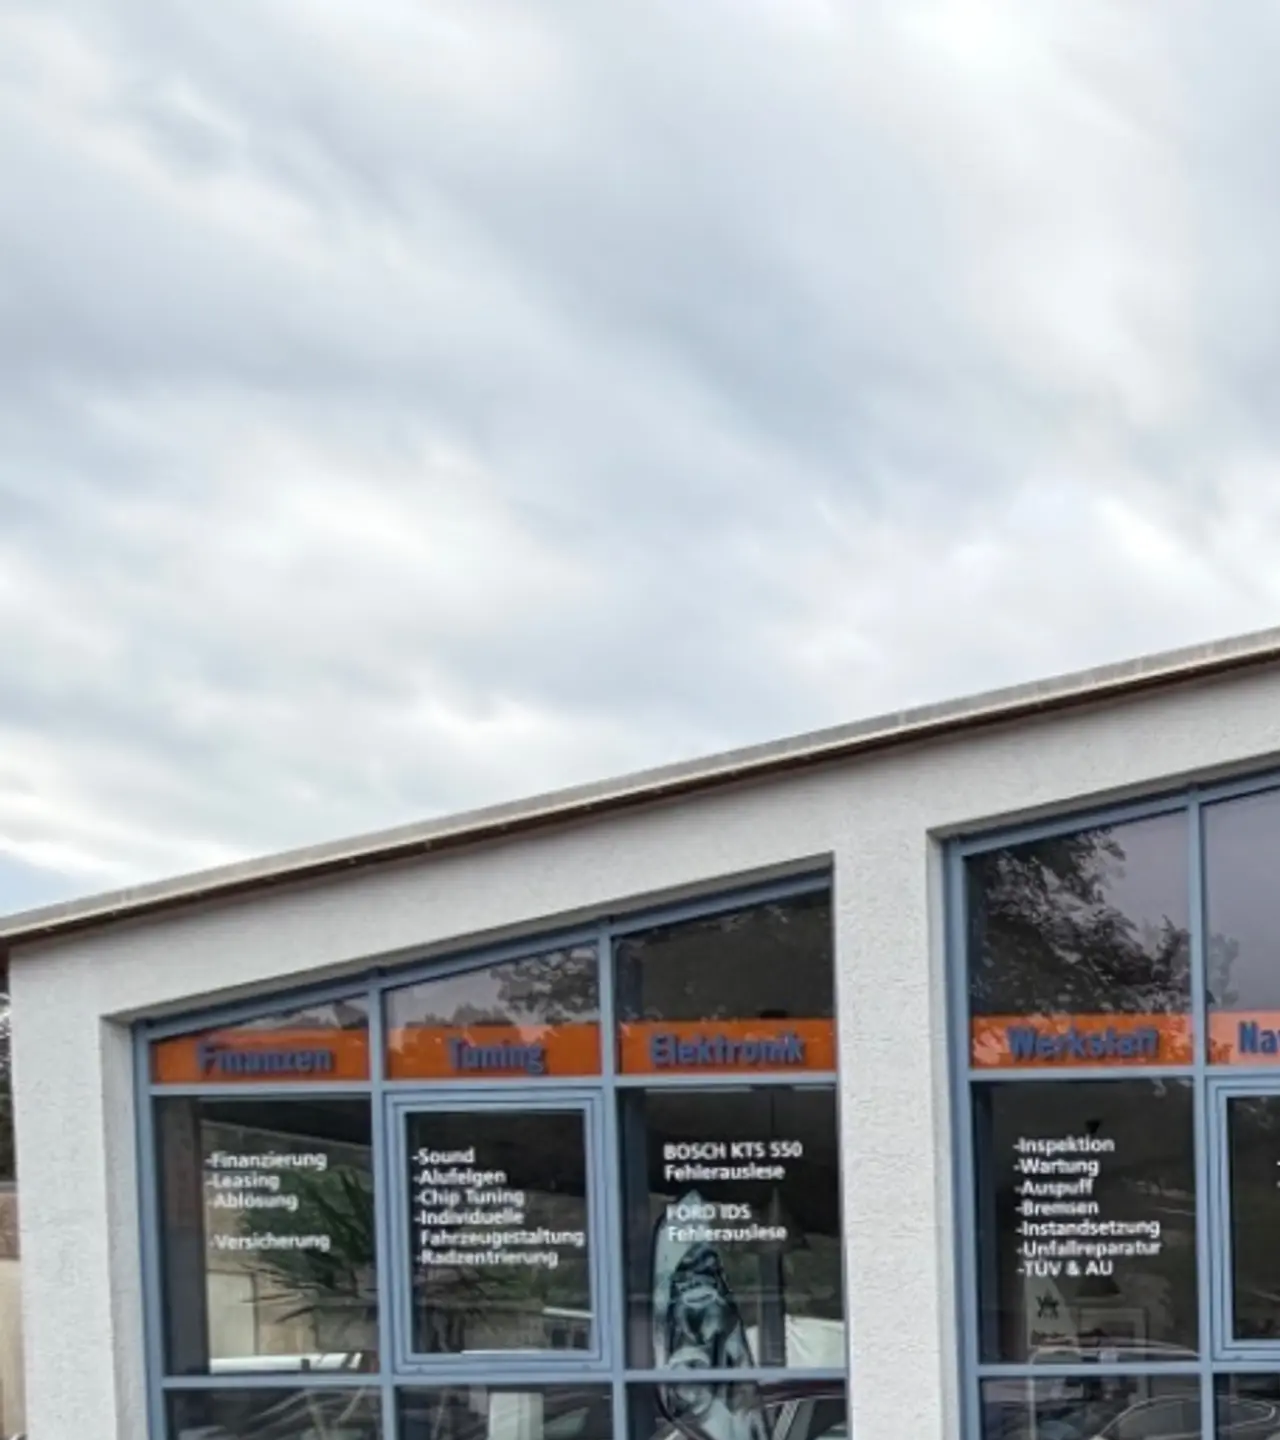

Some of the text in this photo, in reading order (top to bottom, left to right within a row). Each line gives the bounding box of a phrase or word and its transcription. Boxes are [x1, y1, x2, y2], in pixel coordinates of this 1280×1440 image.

[446, 1036, 545, 1075] Tuning
[650, 1031, 806, 1066] Elektronik
[662, 1139, 804, 1161] BOSCH KTS 550
[663, 1161, 787, 1182] Fehlerauslese
[465, 1187, 525, 1208] Tuning
[665, 1202, 752, 1222] FORD IDS
[667, 1223, 790, 1243] Fehlerauslese
[1065, 1259, 1081, 1277] &
[1084, 1259, 1114, 1277] AU
